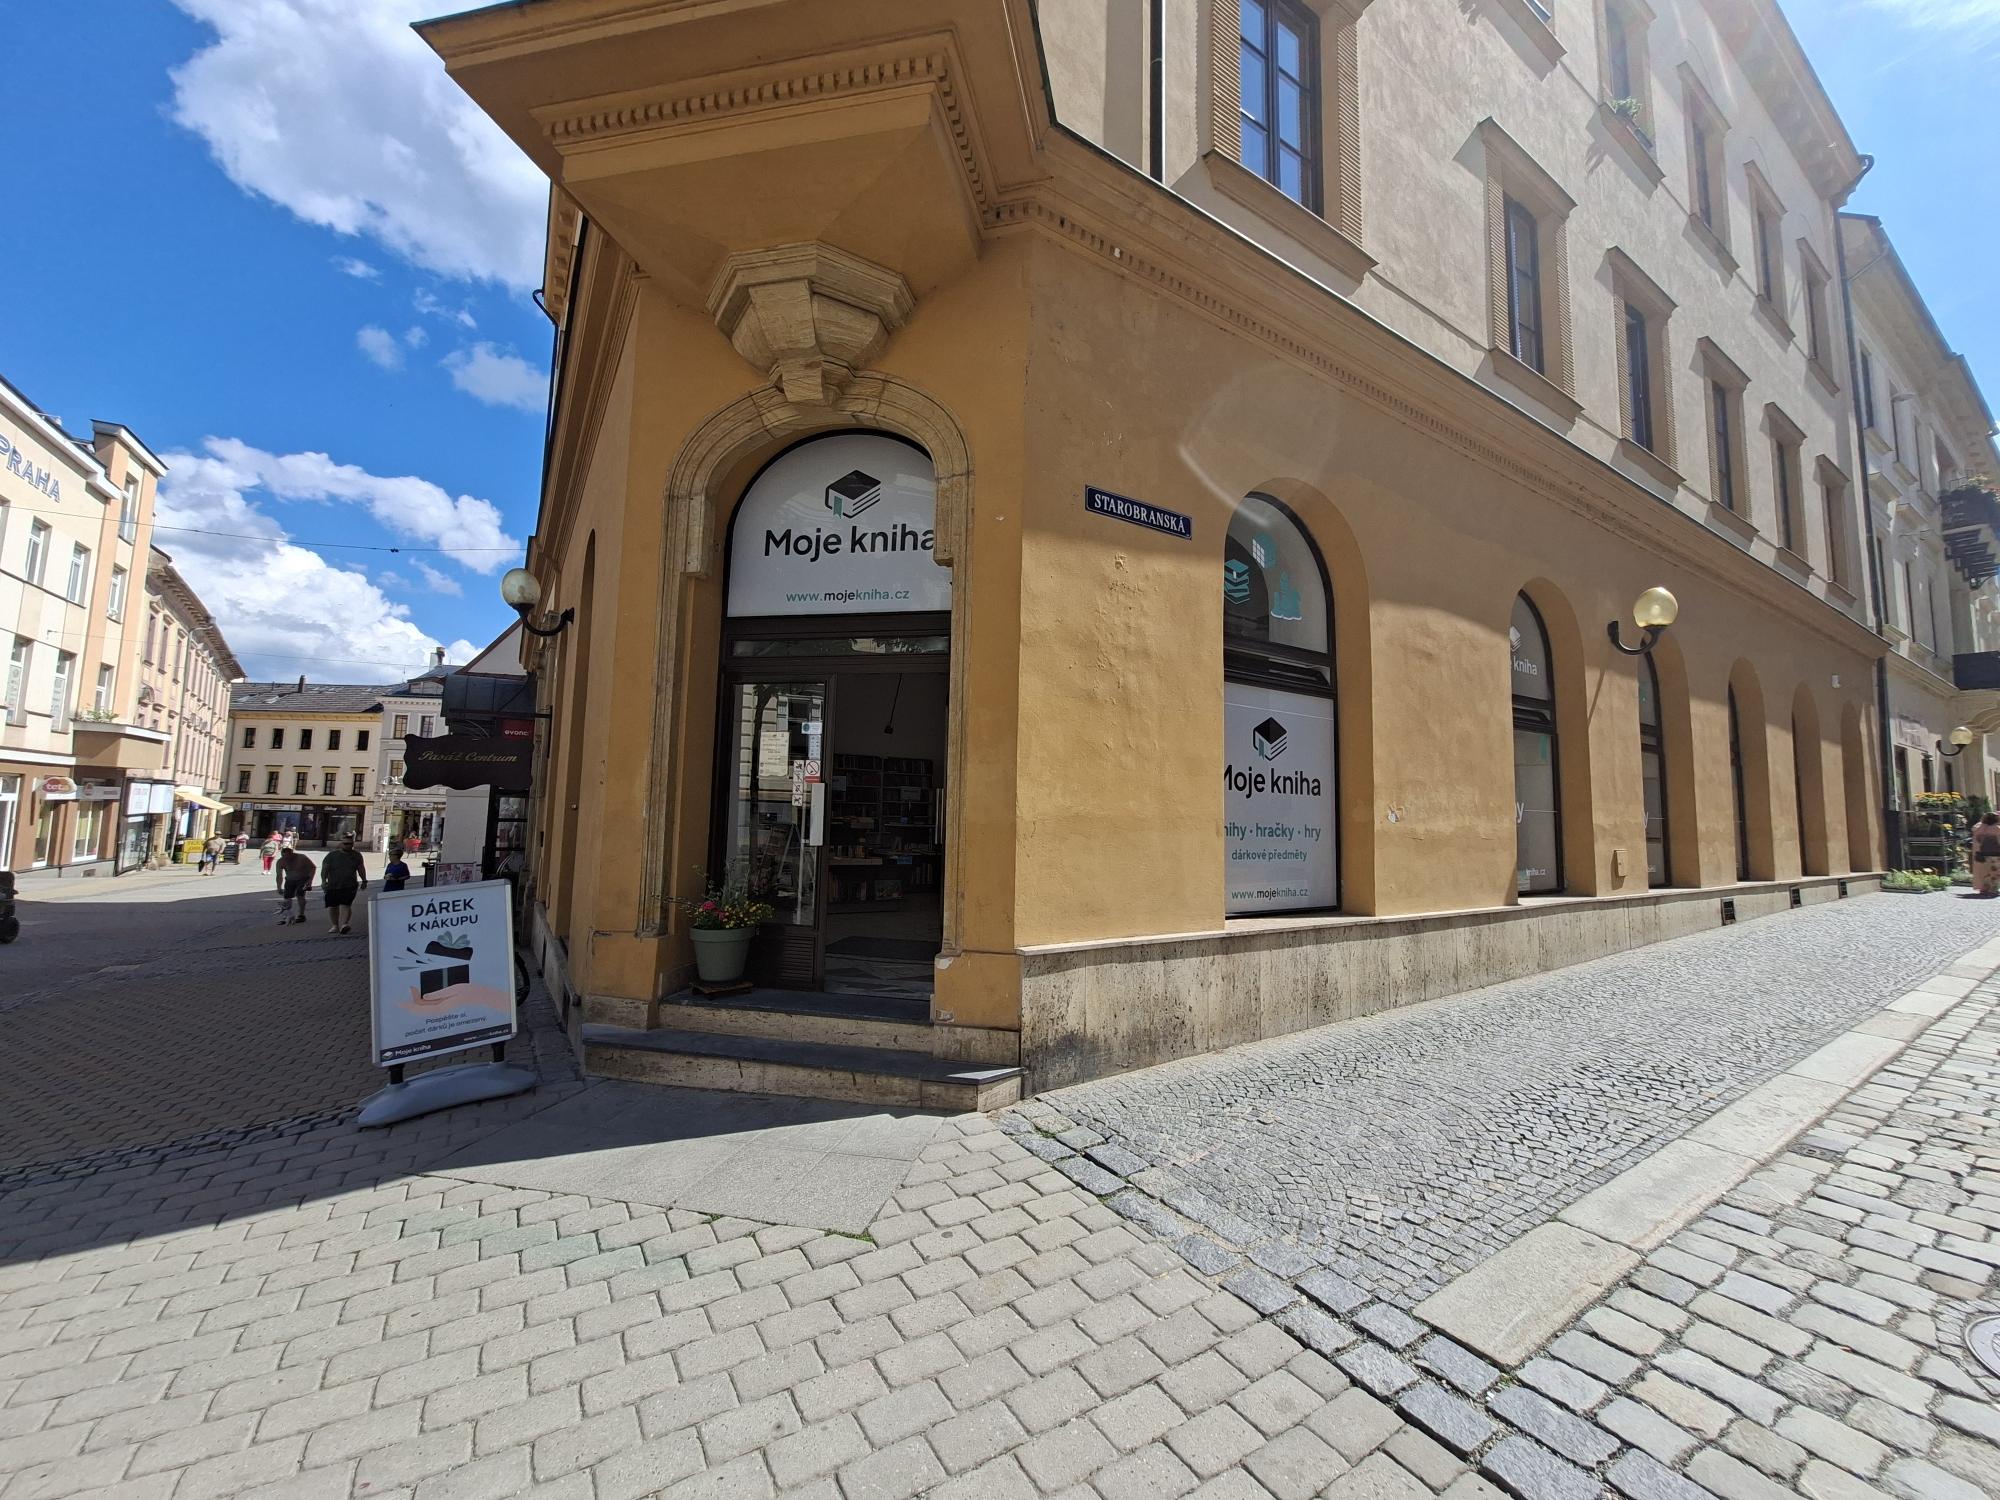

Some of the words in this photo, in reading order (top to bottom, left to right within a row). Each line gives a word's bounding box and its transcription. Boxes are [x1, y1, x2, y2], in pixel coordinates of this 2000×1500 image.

[1094, 493, 1186, 533] STAROBRANSKÁ
[764, 527, 842, 562] Moje
[850, 523, 935, 553] kniha
[785, 588, 910, 604] www.mojekniha.cz
[1513, 656, 1537, 676] kniha
[464, 751, 519, 762] Centrum
[1271, 767, 1321, 797] kniha
[1256, 823, 1294, 842] hračky
[1304, 824, 1321, 842] hry
[1231, 849, 1267, 861] dárkové
[1268, 849, 1307, 862] předměty
[1231, 887, 1309, 900] www.mojekniha.cz
[411, 898, 475, 918] DÁREK
[408, 922, 417, 933] K
[420, 914, 479, 932] NÁKUPU
[395, 1048, 411, 1057] Moje
[412, 1044, 432, 1053] kniha
